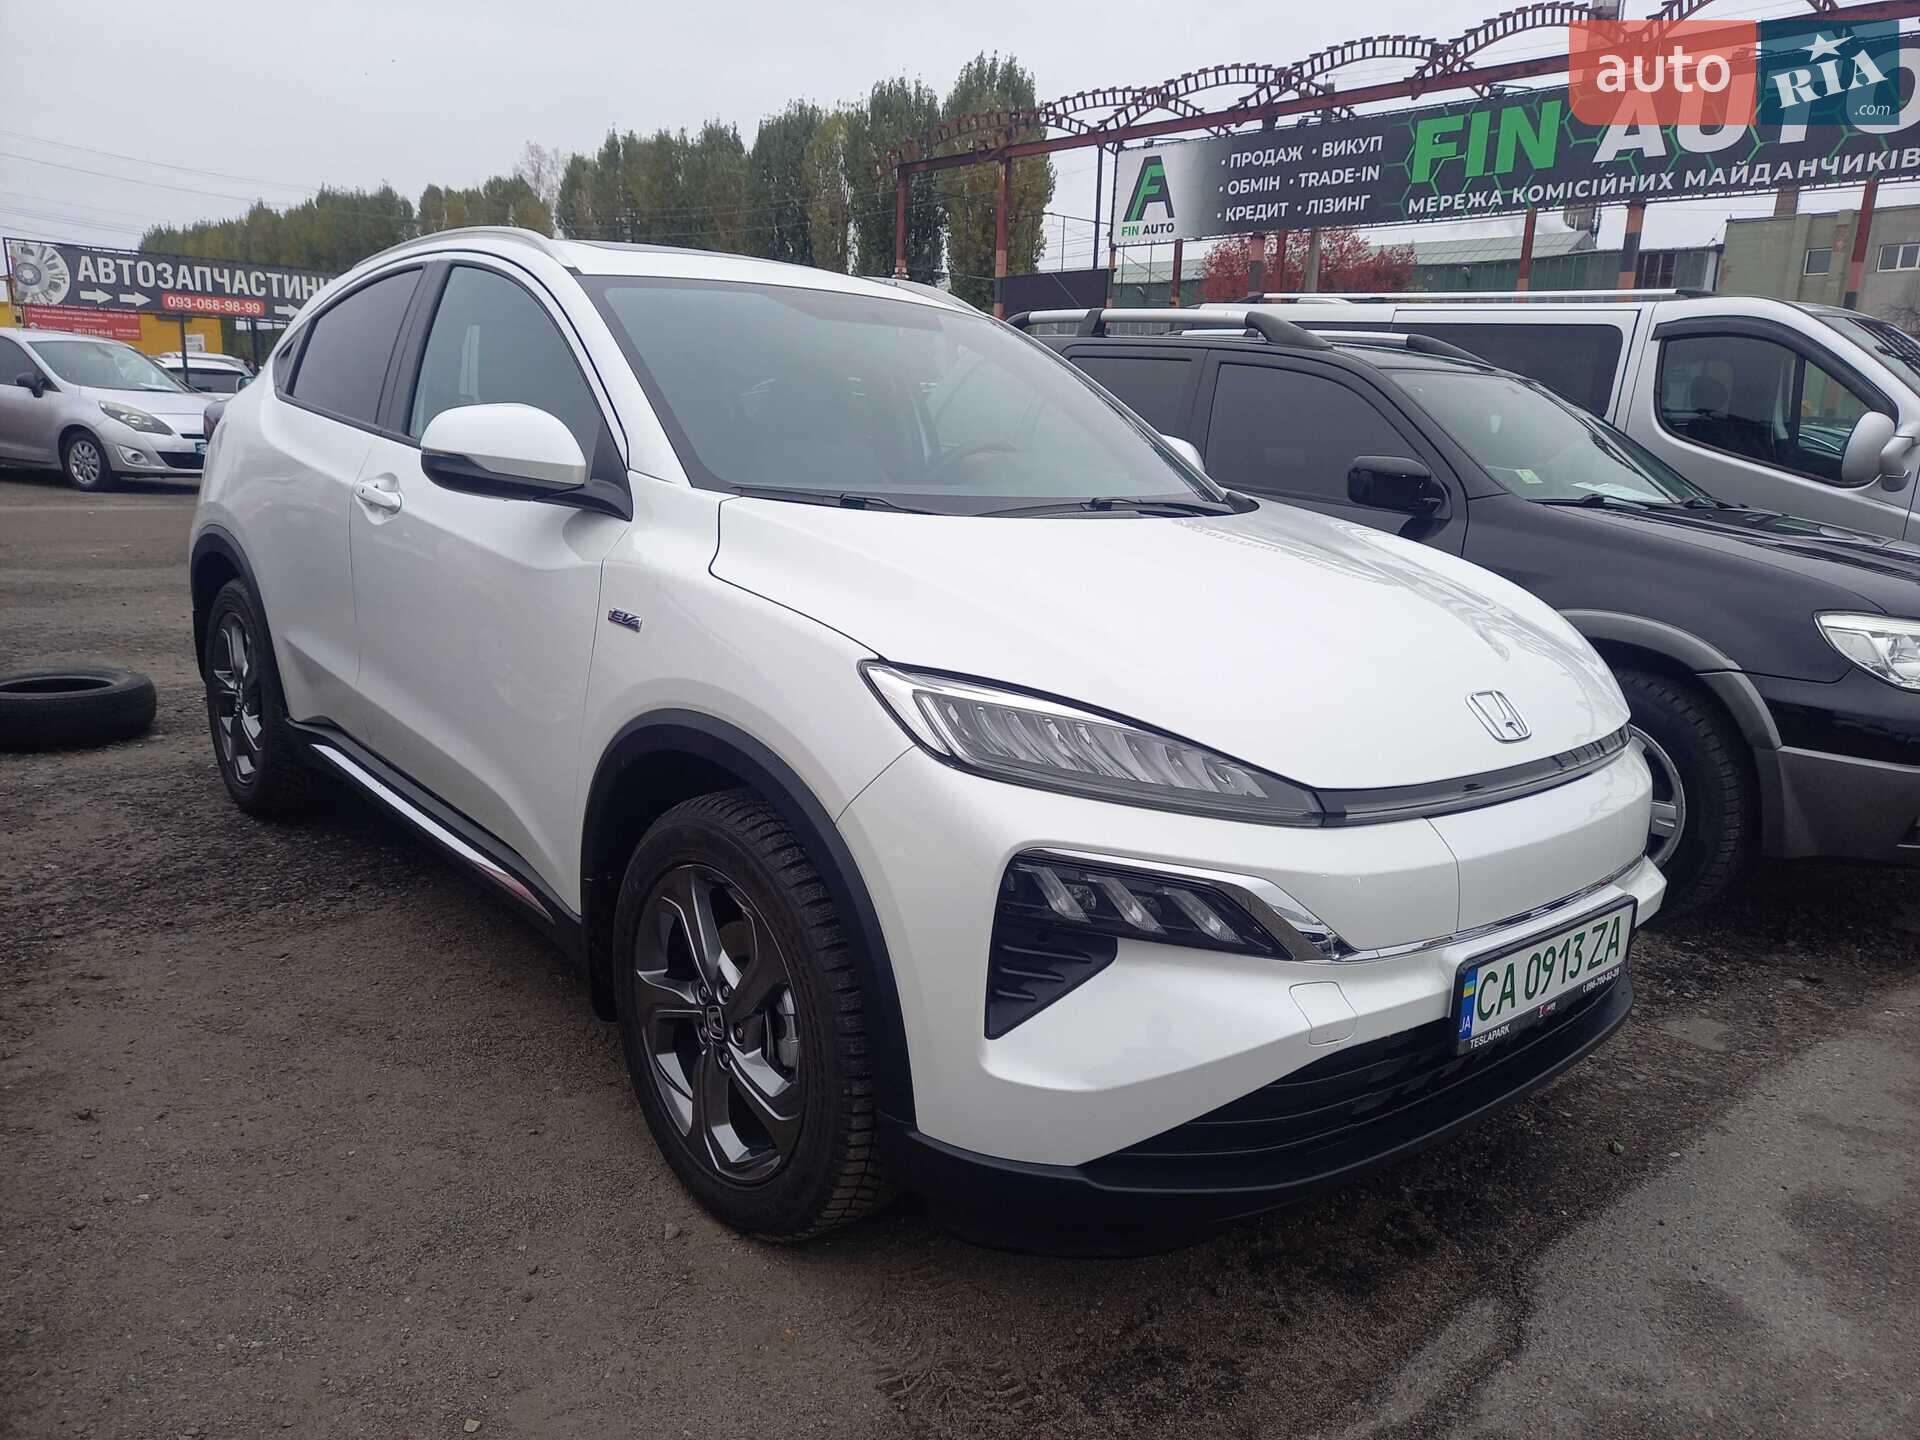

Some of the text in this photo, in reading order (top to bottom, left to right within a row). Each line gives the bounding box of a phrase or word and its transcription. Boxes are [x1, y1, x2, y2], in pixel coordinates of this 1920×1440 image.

[1229, 135, 1384, 169] ПРОДАЖ ВИКУП
[1411, 100, 1563, 184] FIN
[1227, 165, 1381, 196] ОБМІН TRADE-IN
[1407, 146, 1920, 214] МЕРЕЖА КОМІСІЙНИХ МАЙДАНЧИКІВ
[1225, 194, 1371, 223] КРЕДИТ ЛІЗИНГ
[1121, 222, 1176, 238] FIN AUTO
[1476, 915, 1621, 1022] CA 0913 ZA
[1469, 1025, 1510, 1049] TESLAPARK
